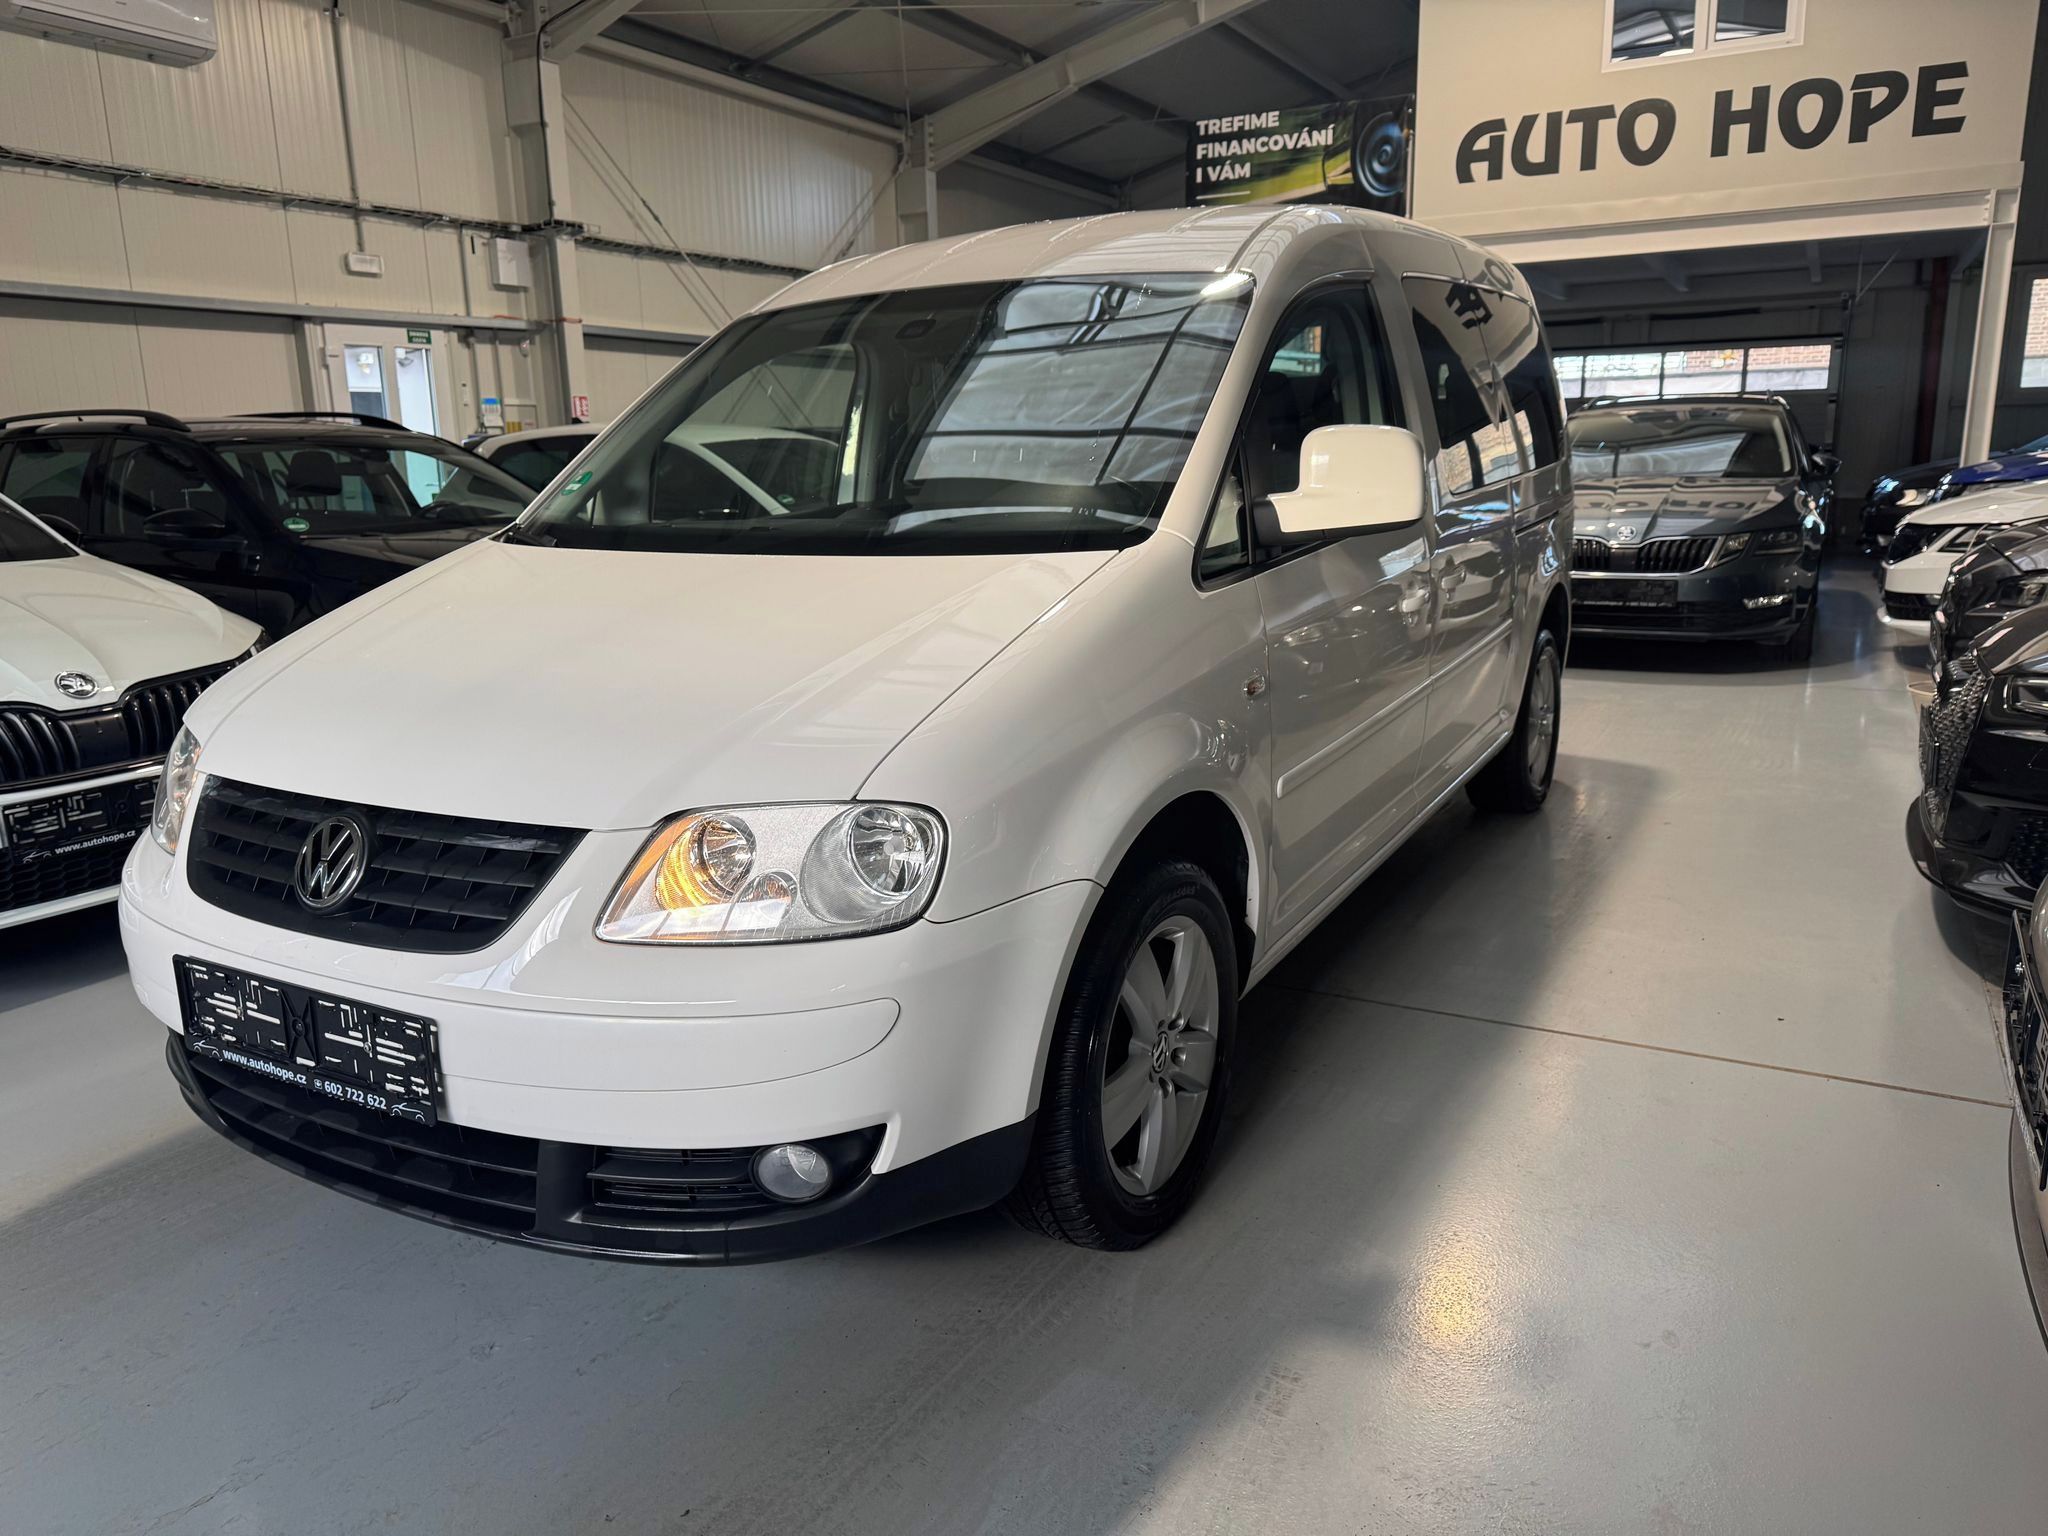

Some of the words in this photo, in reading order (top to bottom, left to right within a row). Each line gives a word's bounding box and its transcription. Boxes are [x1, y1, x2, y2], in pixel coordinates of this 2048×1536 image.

[1196, 111, 1280, 136] TREFIME
[1455, 97, 1676, 184] AUTO
[1710, 61, 1969, 158] HOPE
[1196, 124, 1335, 159] FINANCOVÁNÍ
[1195, 167, 1202, 183] I
[1207, 160, 1251, 182] VÁM
[54, 829, 137, 855] www.autohope.cz
[222, 1049, 307, 1085] www.autohope.cz
[324, 1081, 343, 1097] 602
[345, 1087, 365, 1103] 722
[367, 1094, 387, 1110] 622
